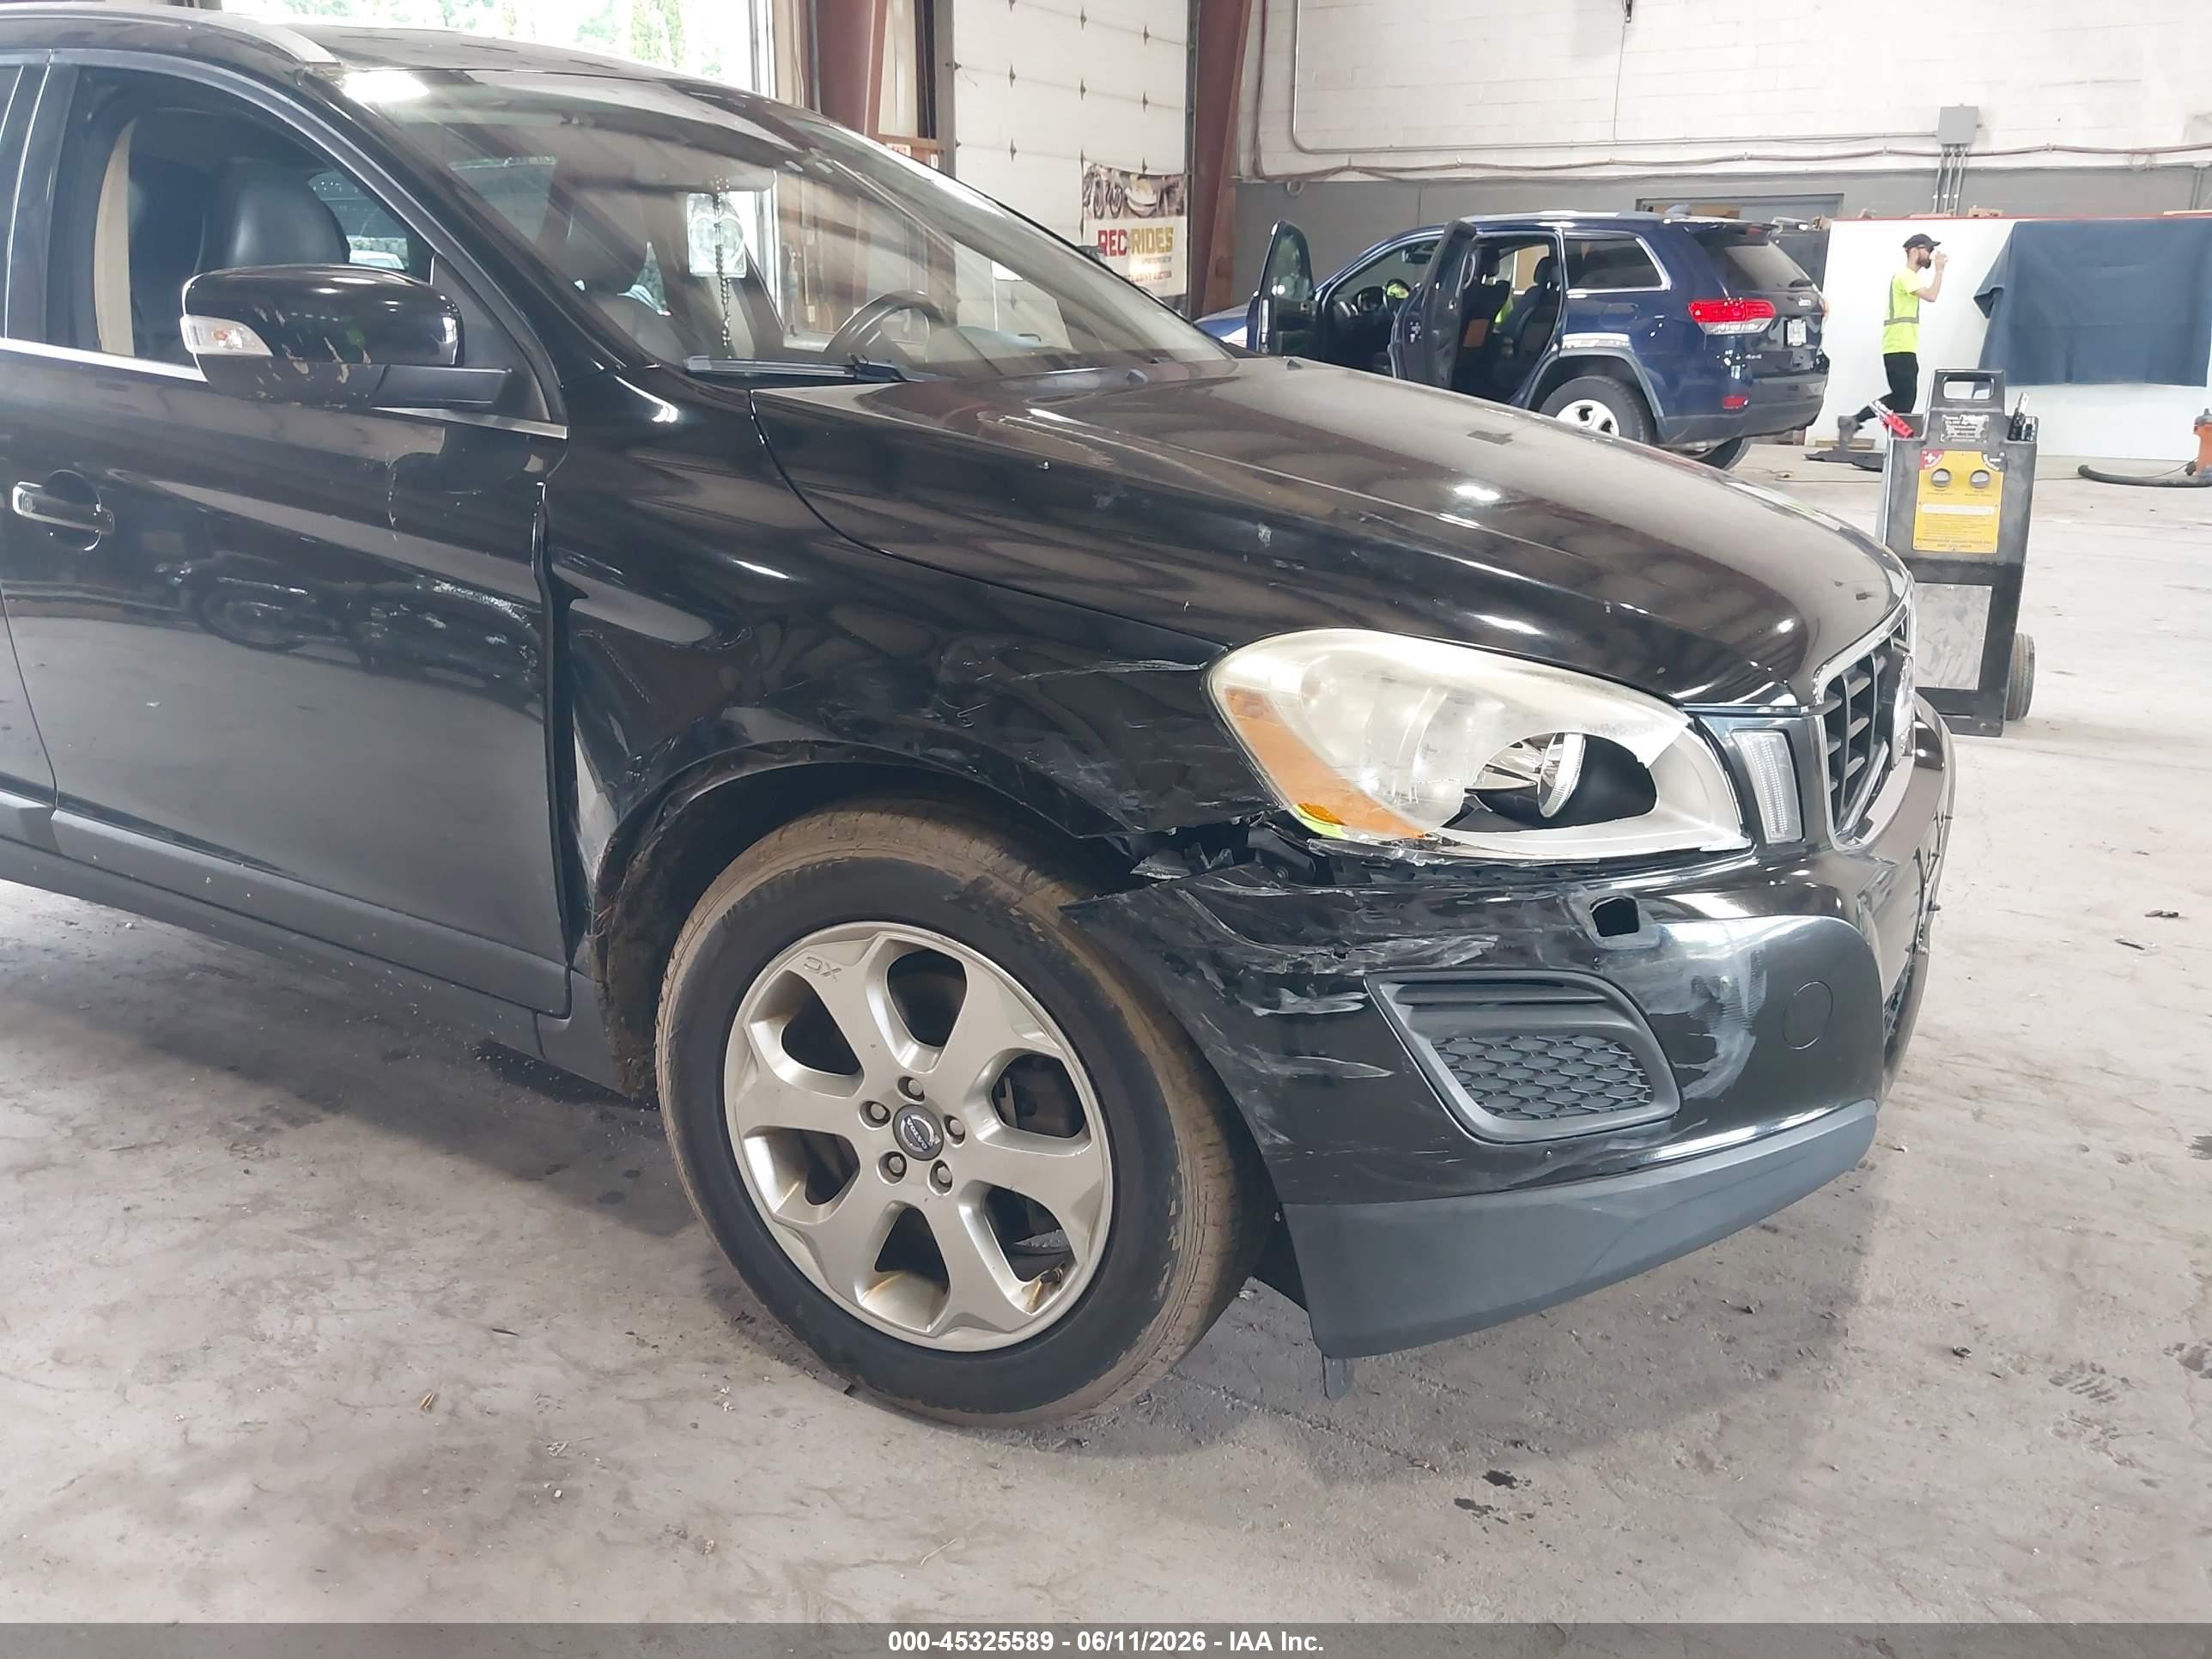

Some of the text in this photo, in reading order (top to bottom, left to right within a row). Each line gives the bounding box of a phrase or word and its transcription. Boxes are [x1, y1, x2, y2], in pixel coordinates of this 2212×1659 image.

[1097, 227, 1174, 257] REC RIDES
[906, 1117, 928, 1150] VOLVO
